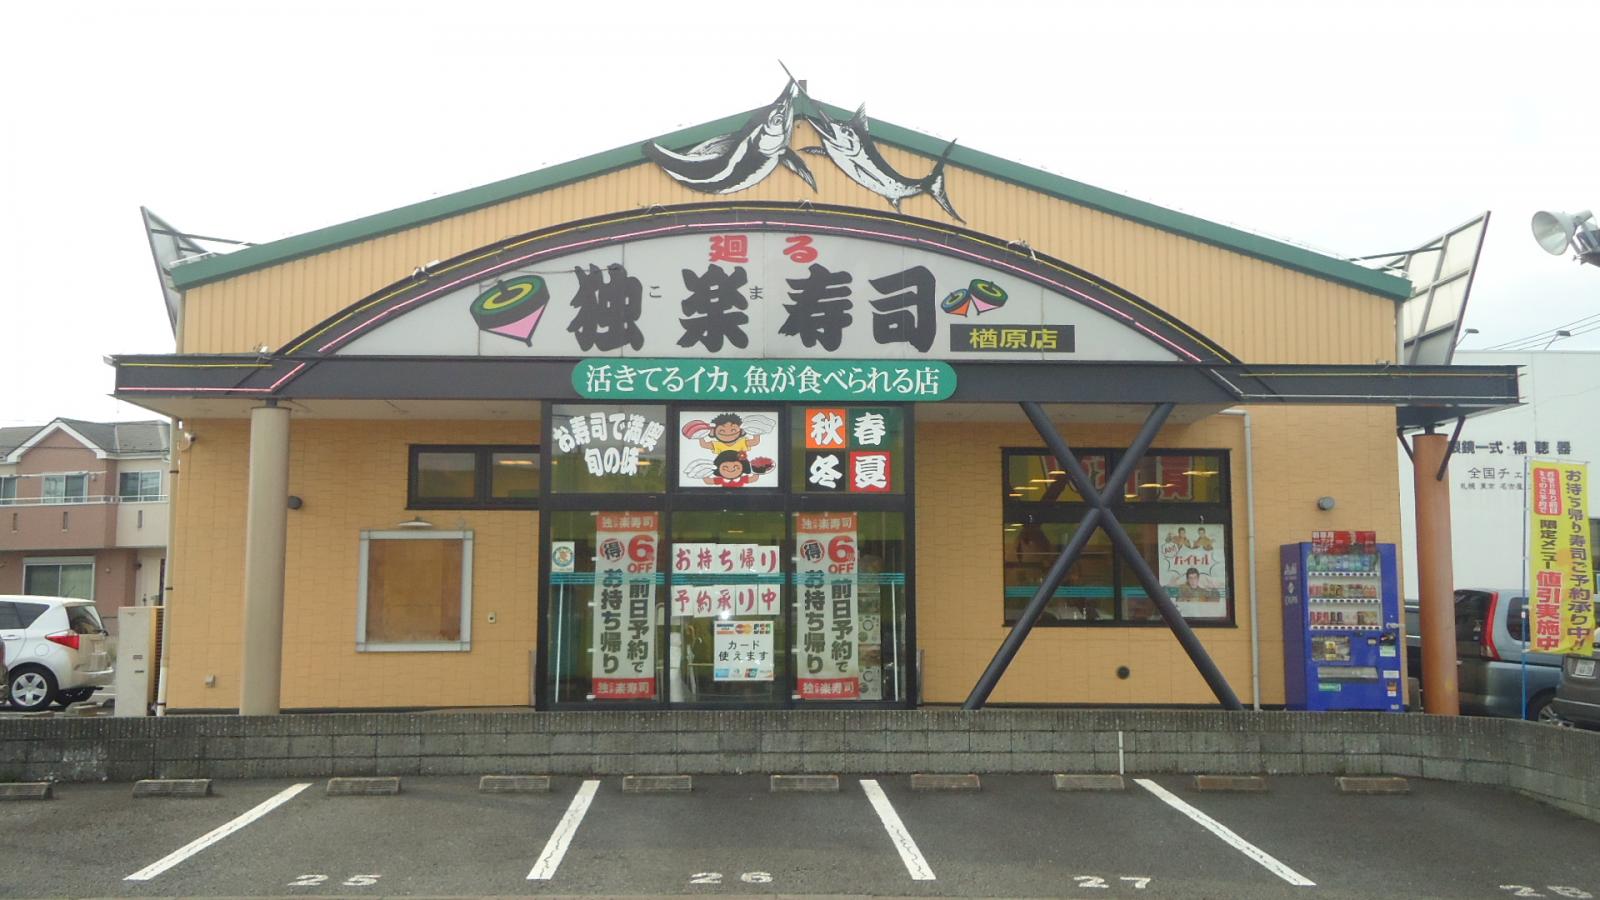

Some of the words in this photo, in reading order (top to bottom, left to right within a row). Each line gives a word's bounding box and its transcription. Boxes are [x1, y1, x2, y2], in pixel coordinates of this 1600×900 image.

[709, 235, 818, 264] 廻る
[969, 327, 1057, 349] 楢原店
[585, 364, 941, 395] 活きてるイカ、魚が食べられる店
[552, 411, 665, 453] お寿司で満喫
[810, 411, 844, 446] 秋
[853, 411, 887, 446] 春
[584, 446, 640, 476] 旬の味
[809, 453, 843, 489] 冬
[854, 454, 888, 489] 夏
[1468, 467, 1531, 479] 全国チェ
[1540, 520, 1557, 569] 限定メニュー
[627, 562, 653, 573] OFF
[675, 547, 777, 572] お持ち帰り
[828, 563, 854, 574] OFF
[1174, 554, 1209, 566] バイトル
[675, 588, 777, 612] 予約承り中
[1536, 571, 1562, 650] 値引実施中
[600, 568, 622, 674] お持ち帰り
[627, 577, 650, 673] 前日予約で
[804, 569, 825, 674] お持ち帰り
[831, 578, 853, 673] 前日予約で
[718, 651, 768, 661] 使えます
[728, 641, 760, 650] カード
[287, 873, 382, 888] 25
[688, 870, 775, 886] 26
[1073, 875, 1152, 890] 27
